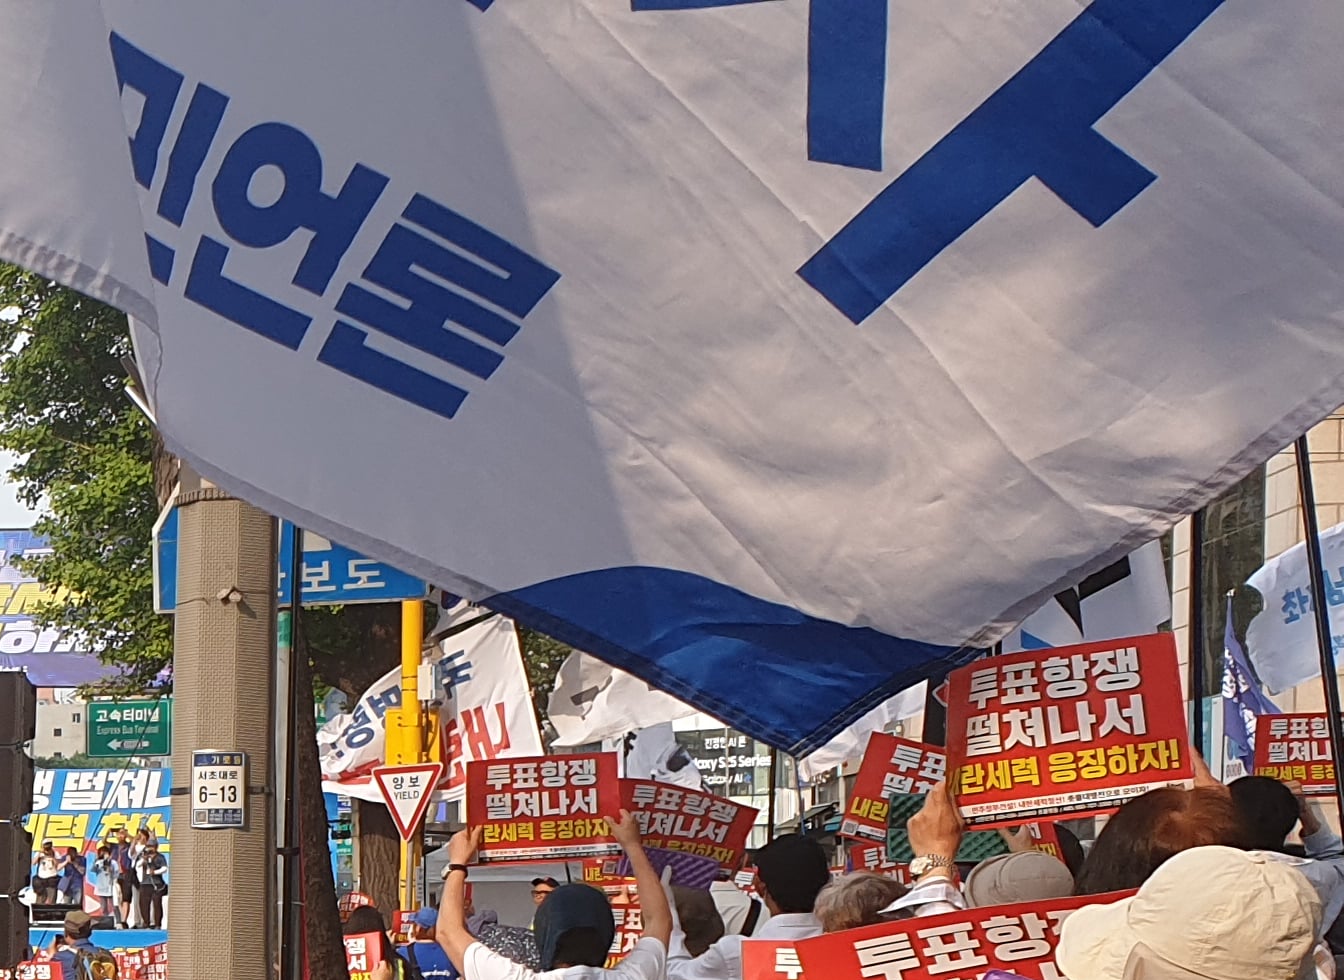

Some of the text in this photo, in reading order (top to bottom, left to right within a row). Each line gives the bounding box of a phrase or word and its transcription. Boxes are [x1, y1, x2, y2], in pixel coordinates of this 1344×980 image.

[968, 647, 1141, 709] 투표항쟁
[96, 708, 160, 722] 고속터미널
[966, 694, 1147, 756] 떨쳐나서
[738, 756, 772, 767] Series
[1049, 737, 1180, 784] 응징하자!
[198, 771, 238, 780] 서초대로
[392, 776, 420, 790] 양보
[485, 761, 598, 792] 투표항쟁
[199, 786, 238, 803] 6-13
[394, 790, 420, 800] YIELD
[485, 791, 599, 820] 떨쳐나서
[632, 784, 738, 824] 투표항쟁
